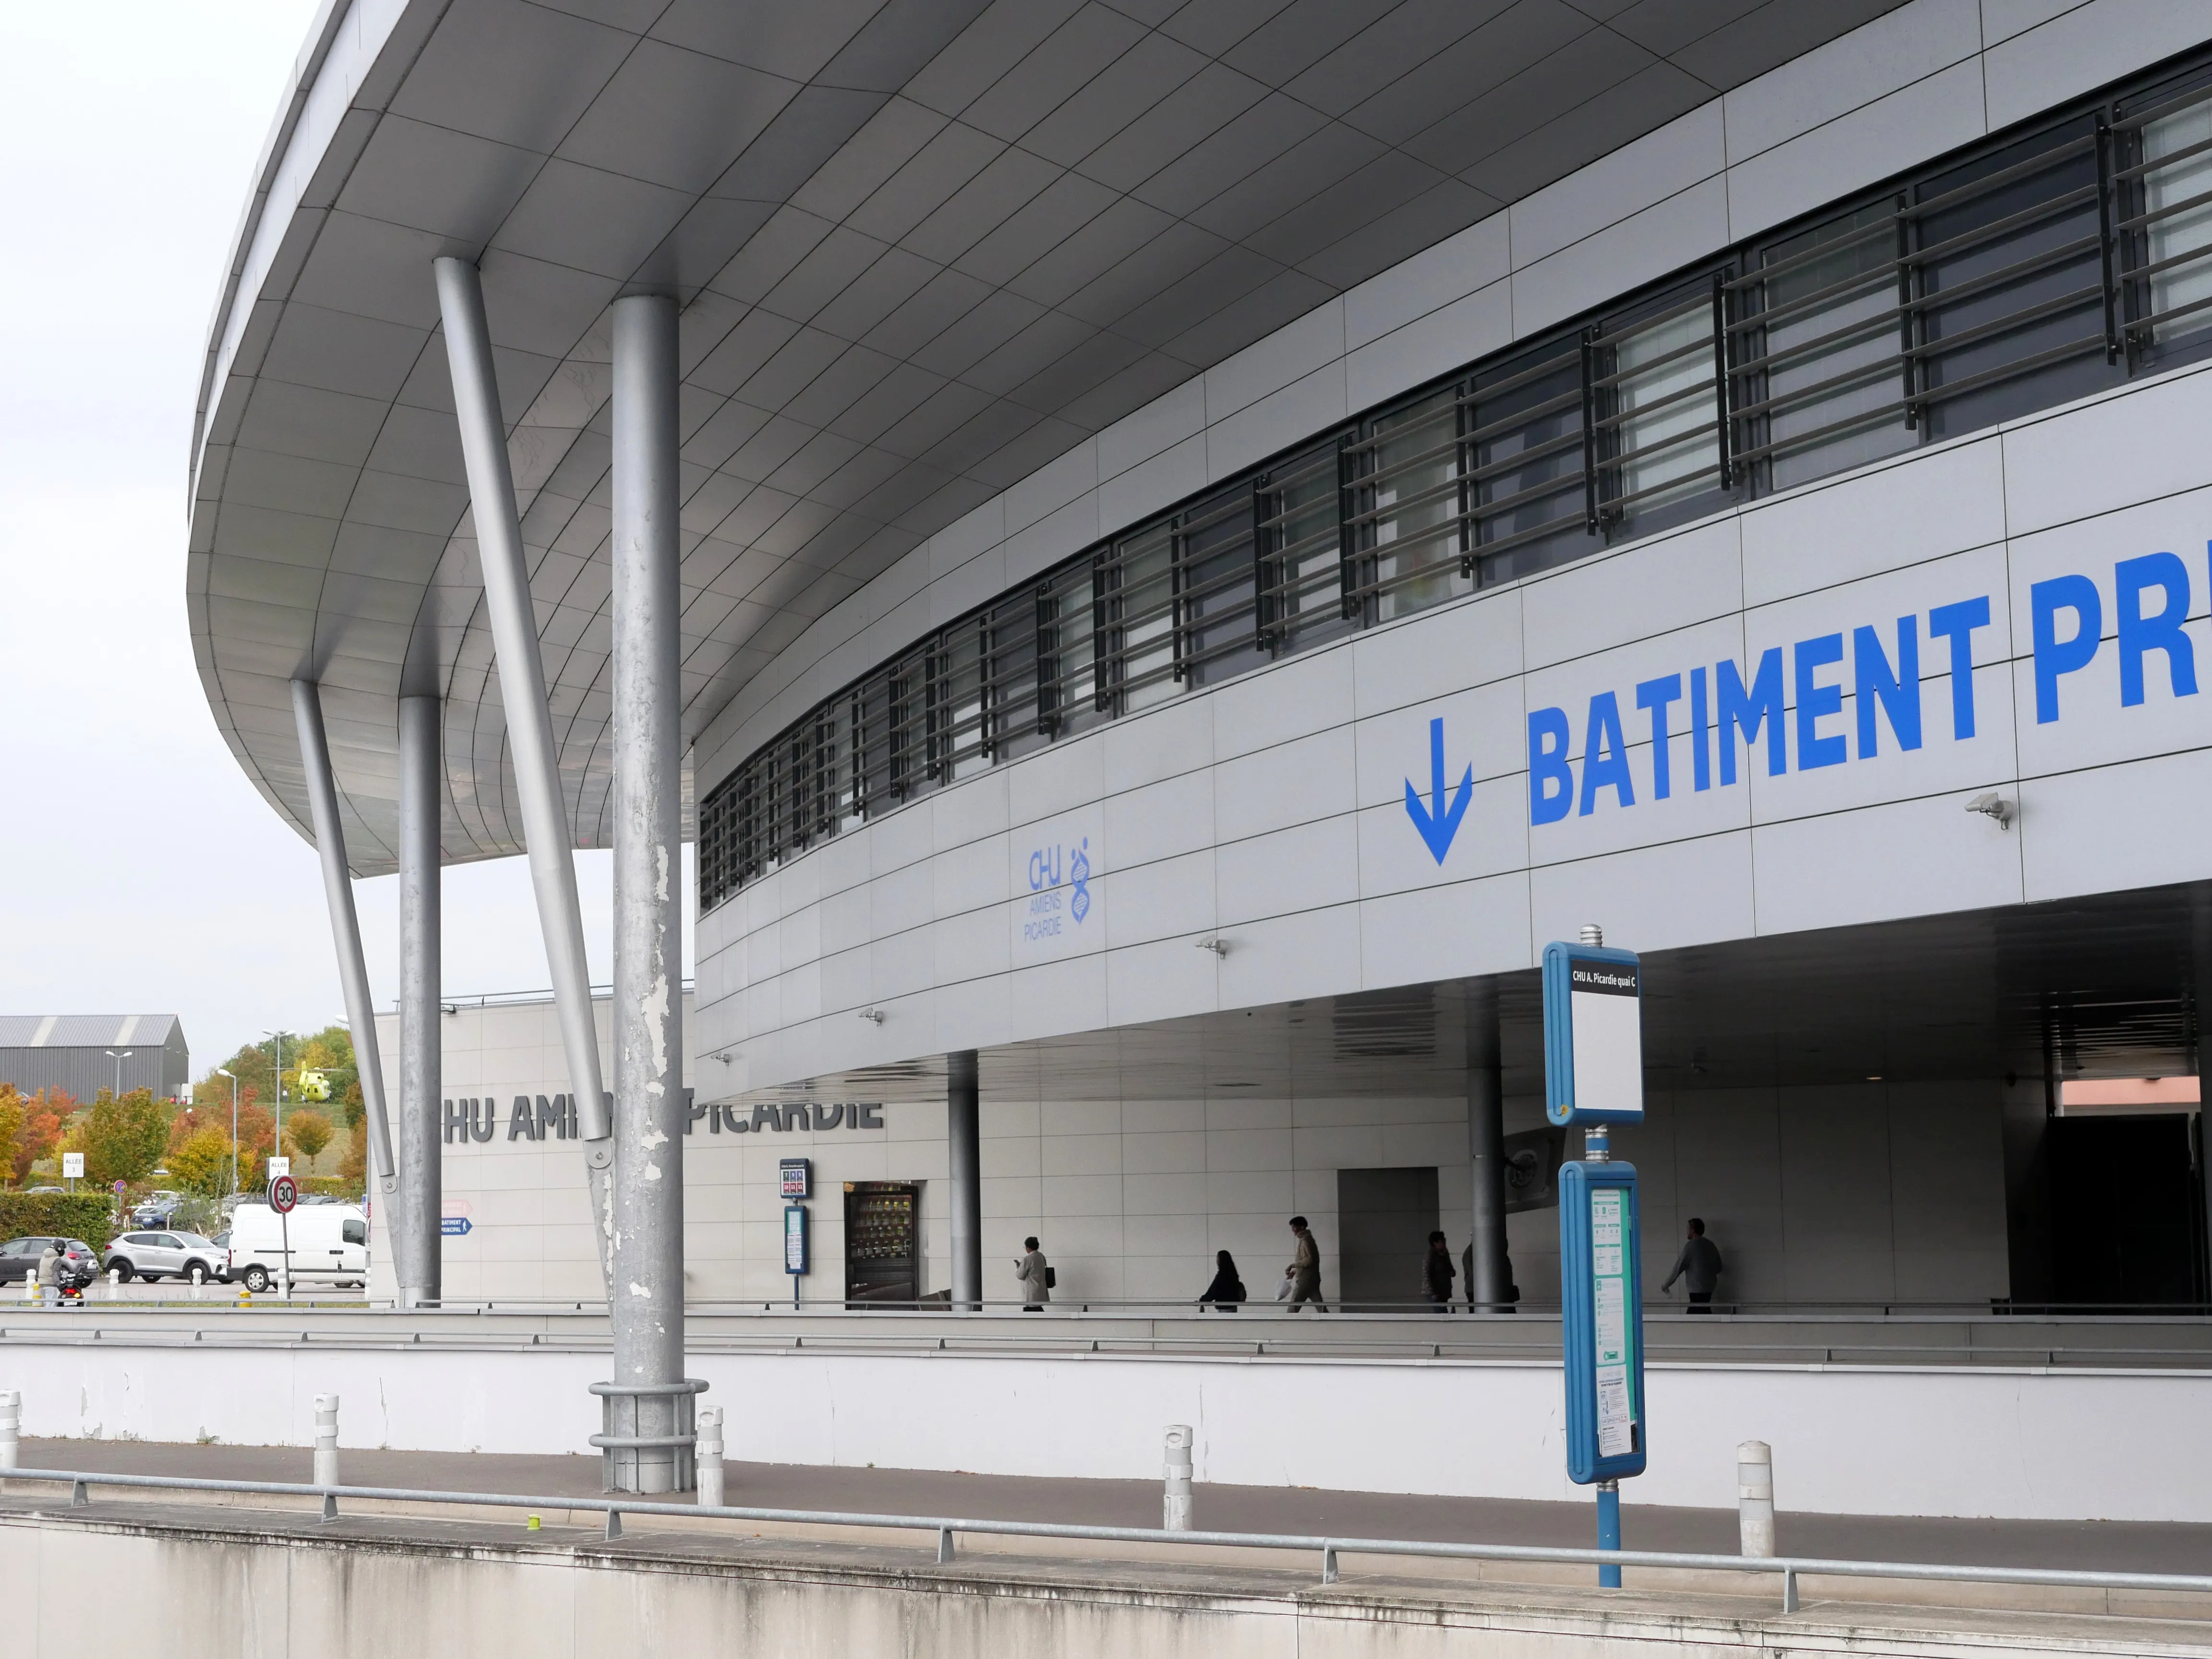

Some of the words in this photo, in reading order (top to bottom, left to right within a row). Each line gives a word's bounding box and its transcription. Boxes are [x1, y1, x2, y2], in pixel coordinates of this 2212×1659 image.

[1528, 595, 1990, 826] BATIMENT
[2031, 539, 2212, 725] PR
[1029, 844, 1060, 890] CHU
[1030, 891, 1061, 916] AMIENS
[1024, 916, 1062, 942] PICARDIE
[1573, 970, 1586, 982] CHU
[1587, 972, 1593, 983] A.
[1593, 972, 1617, 986] Picardie
[1617, 975, 1631, 988] quai
[1631, 976, 1635, 987] C
[444, 1097, 494, 1143] HU
[279, 1186, 293, 1202] 30
